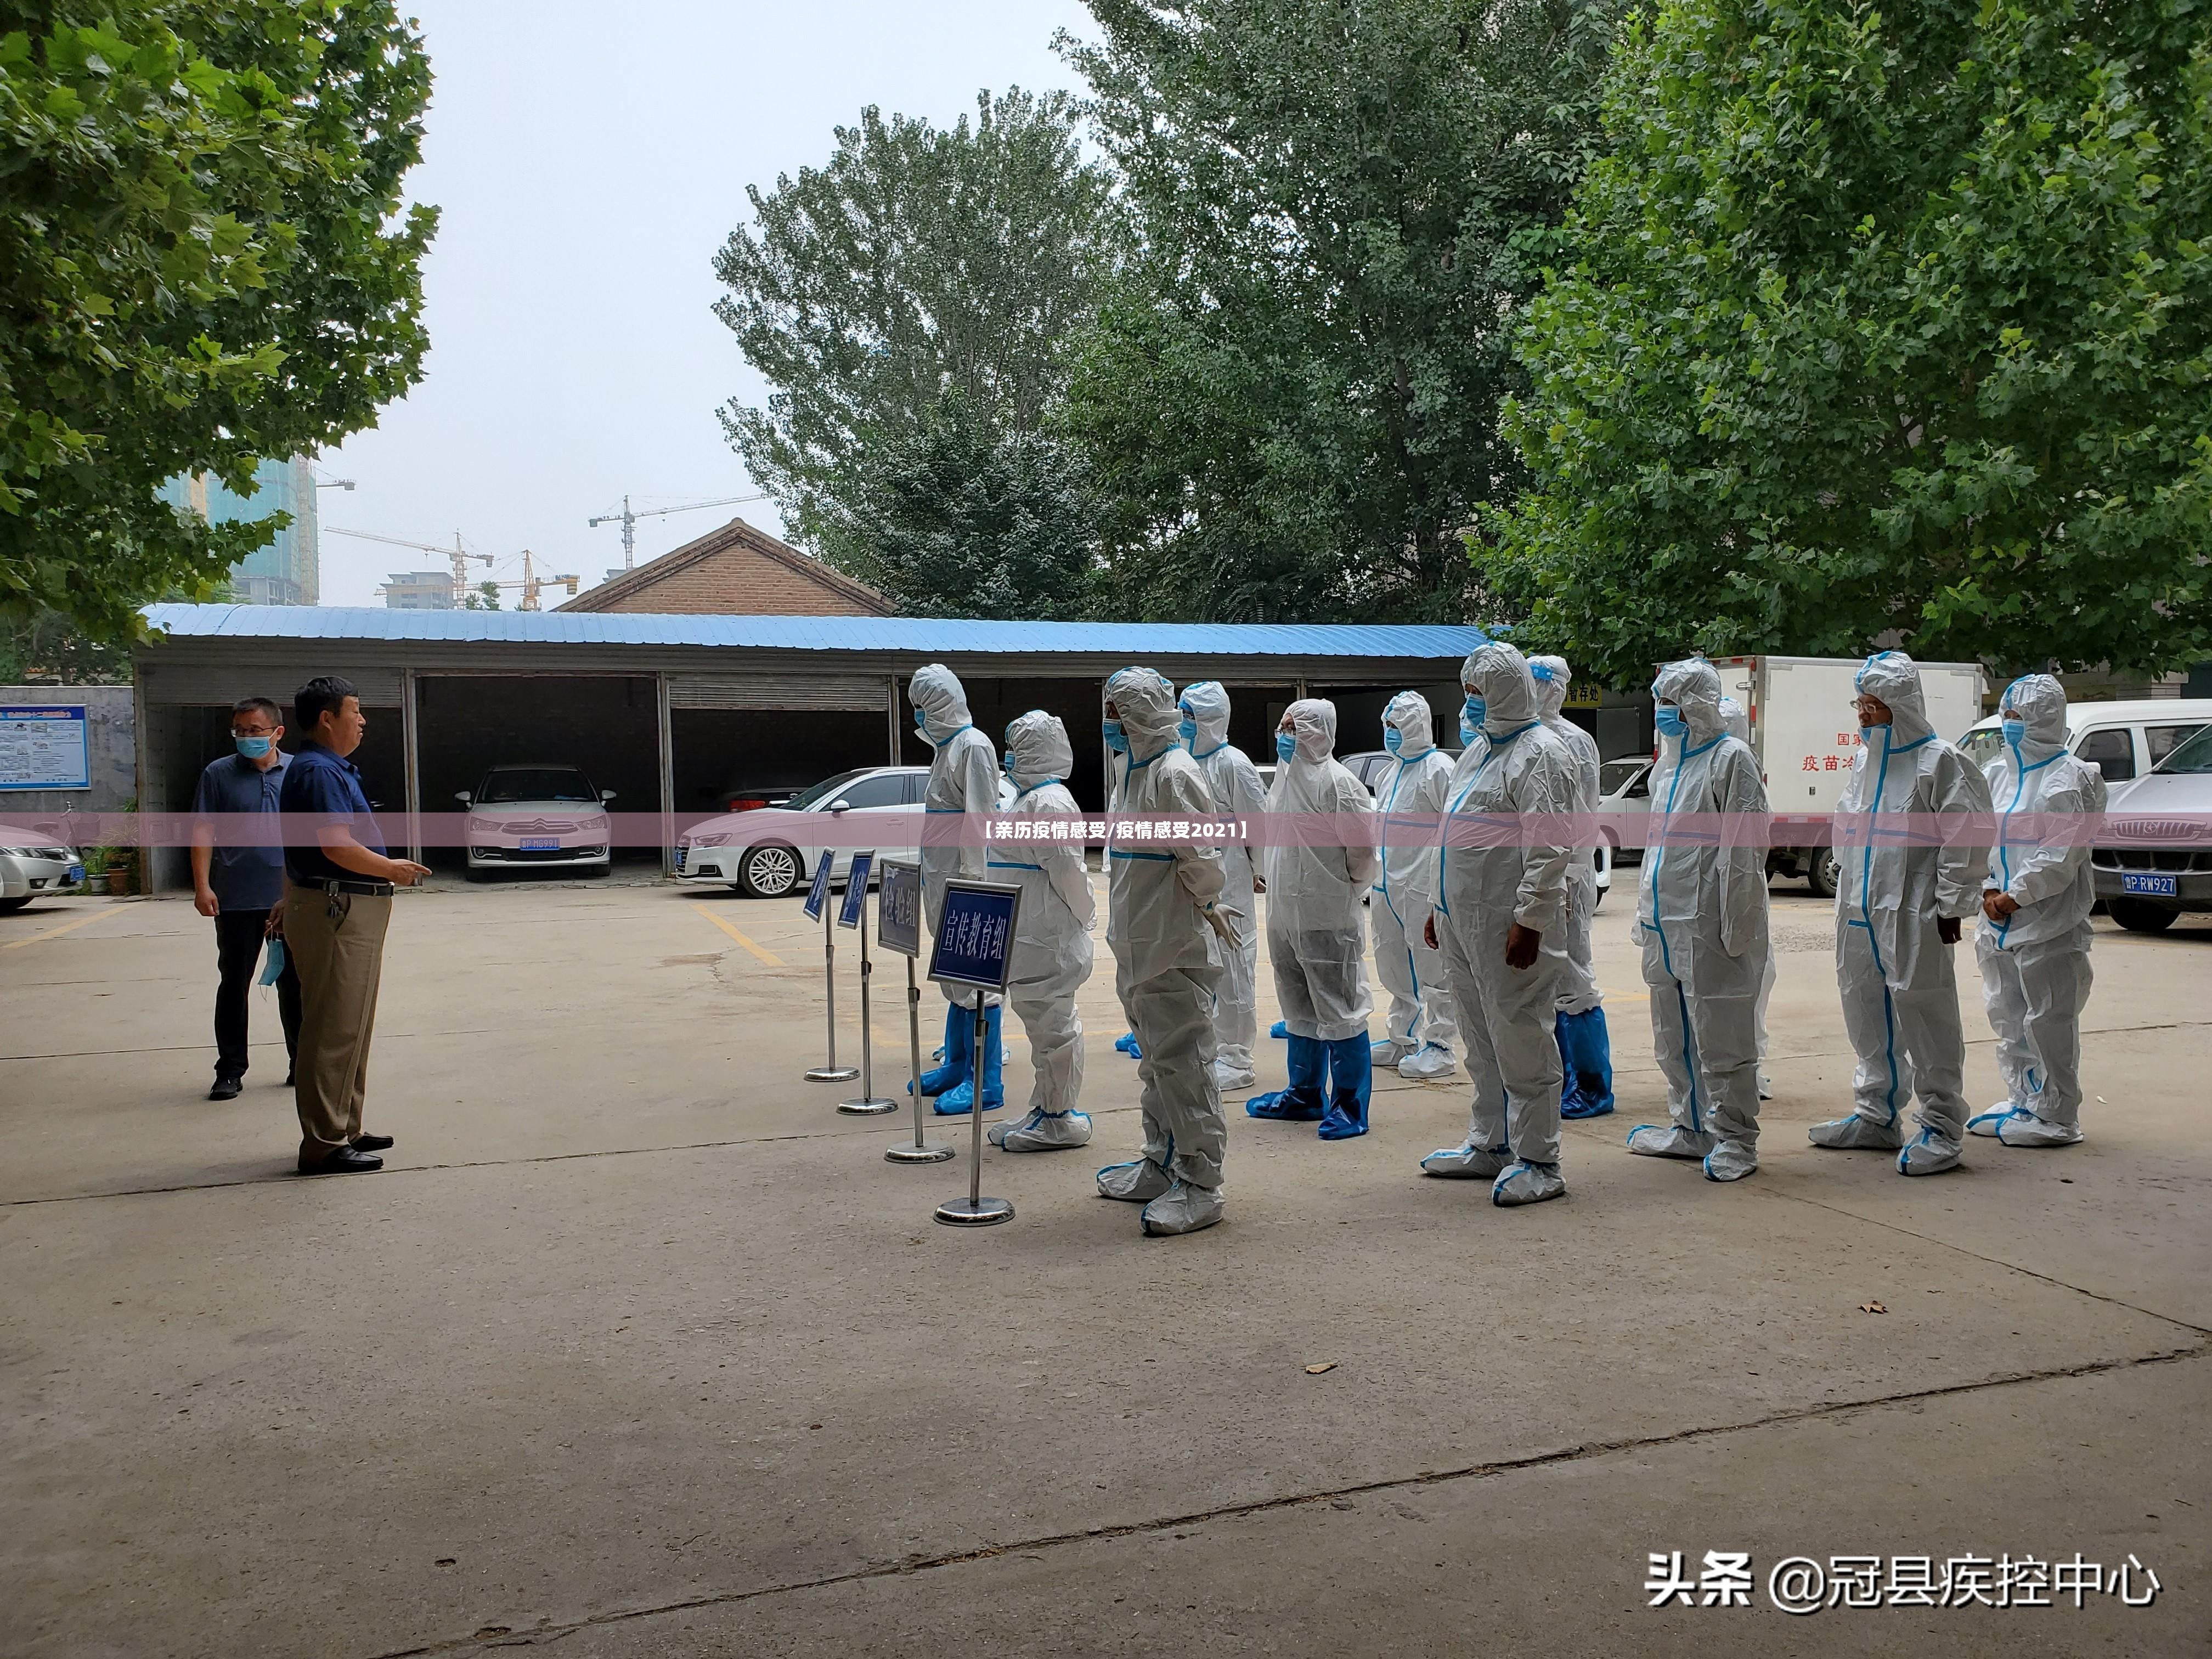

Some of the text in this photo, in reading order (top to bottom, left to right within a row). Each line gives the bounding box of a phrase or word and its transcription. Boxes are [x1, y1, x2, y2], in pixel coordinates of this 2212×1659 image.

[1565, 684, 1599, 702] 暂存处
[942, 909, 1007, 960] 宣传教育组
